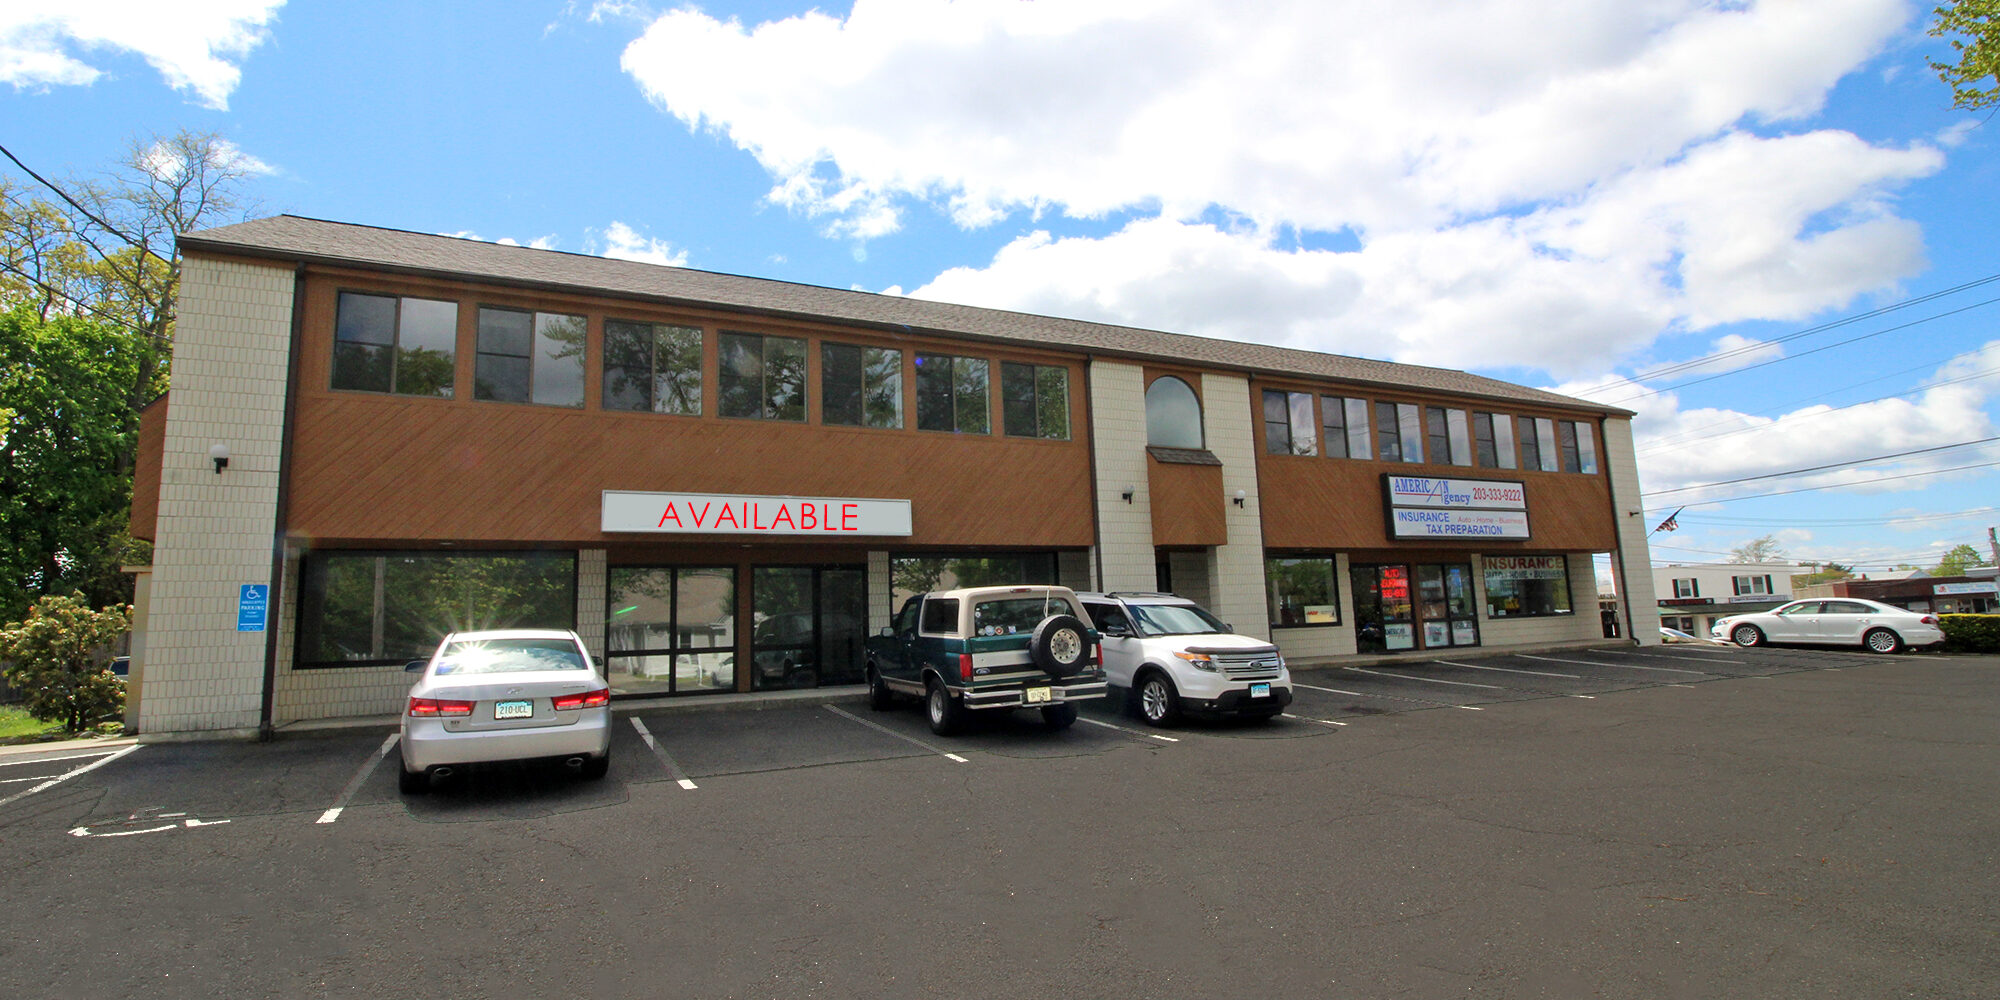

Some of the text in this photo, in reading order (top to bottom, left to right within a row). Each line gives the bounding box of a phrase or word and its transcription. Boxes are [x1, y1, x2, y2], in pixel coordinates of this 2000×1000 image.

[1473, 488, 1521, 501] 203-333-9222
[657, 501, 858, 531] AVAILABLE
[1398, 511, 1450, 523] INSURANCE
[1426, 524, 1503, 535] TAX PREPARATION
[1482, 556, 1564, 570] INSURANCE
